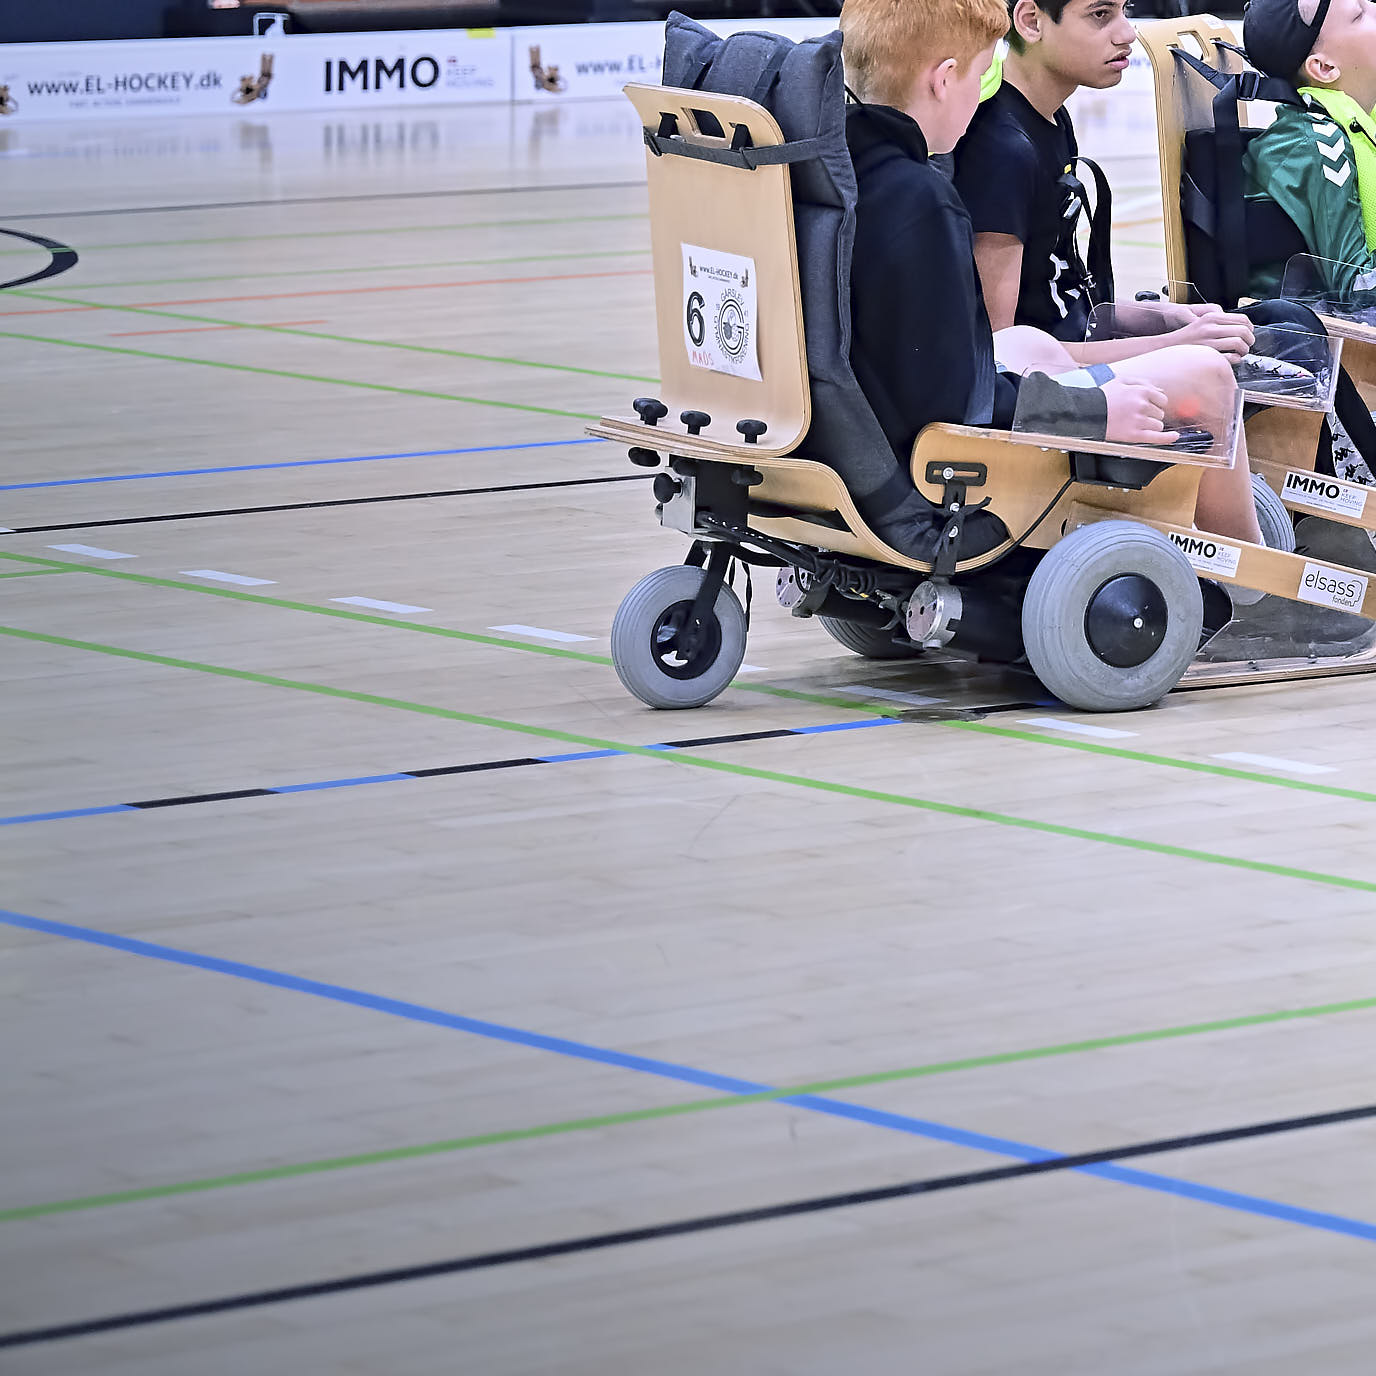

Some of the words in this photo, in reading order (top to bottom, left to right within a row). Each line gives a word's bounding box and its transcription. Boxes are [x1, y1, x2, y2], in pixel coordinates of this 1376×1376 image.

[27, 73, 223, 97] www.EL-HOCKEY.dk
[324, 56, 440, 92] IMMO
[687, 291, 705, 347] 6
[1286, 474, 1340, 499] IMMO
[1304, 570, 1356, 597] elsass
[1331, 595, 1352, 607] fonden
